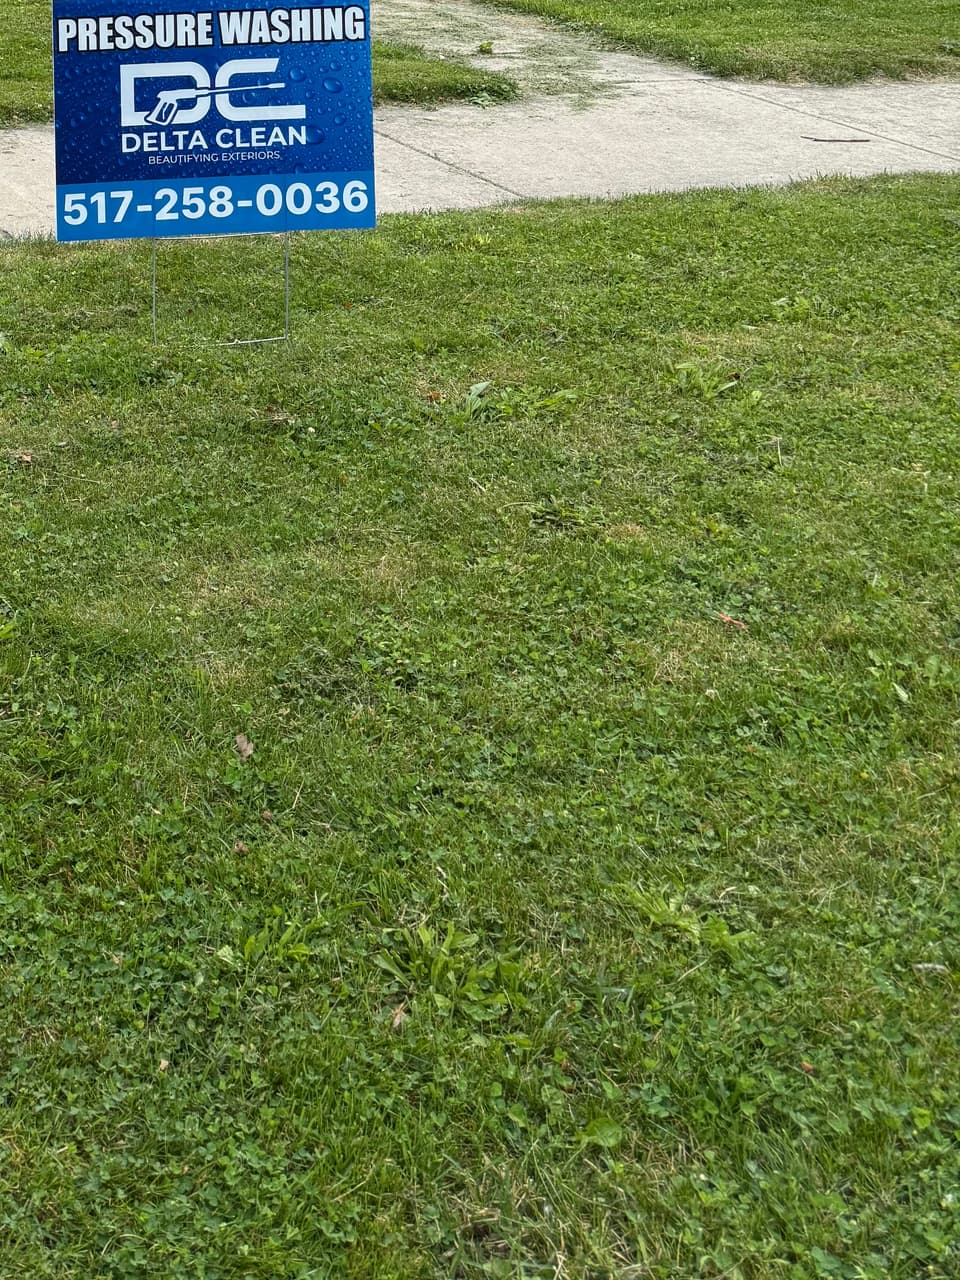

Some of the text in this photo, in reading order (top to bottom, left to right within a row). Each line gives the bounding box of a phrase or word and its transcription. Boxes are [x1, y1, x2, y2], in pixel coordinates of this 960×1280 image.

[58, 7, 365, 52] PRESSURE WASHING
[120, 57, 306, 127] DC
[121, 125, 307, 153] DELTA CLEAN
[148, 150, 280, 165] BEAUTIFYING EXTERIORS
[63, 180, 369, 226] 517-258-0036
